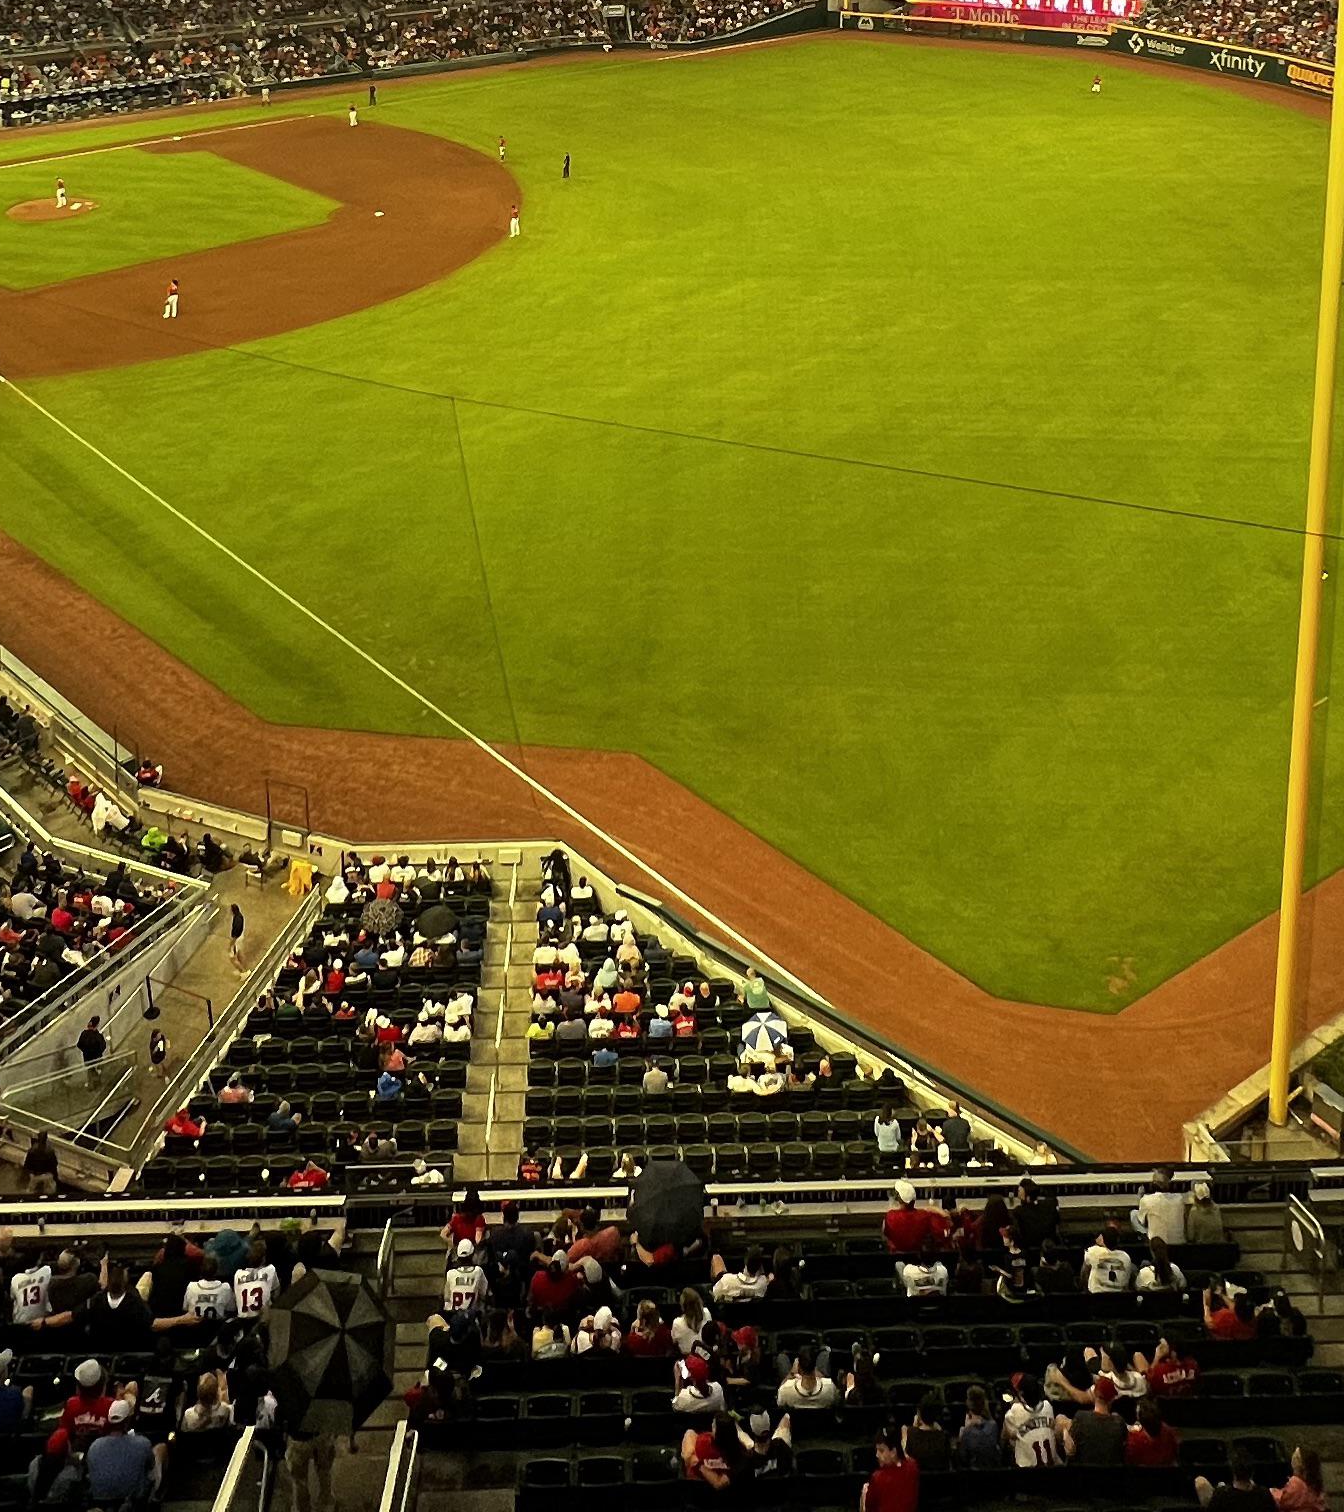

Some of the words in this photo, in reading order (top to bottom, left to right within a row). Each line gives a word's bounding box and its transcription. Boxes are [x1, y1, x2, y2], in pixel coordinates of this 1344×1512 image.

[1209, 48, 1266, 78] xfinity
[23, 1286, 41, 1307] 13
[241, 1287, 264, 1313] 13
[1032, 1438, 1054, 1465] 11
